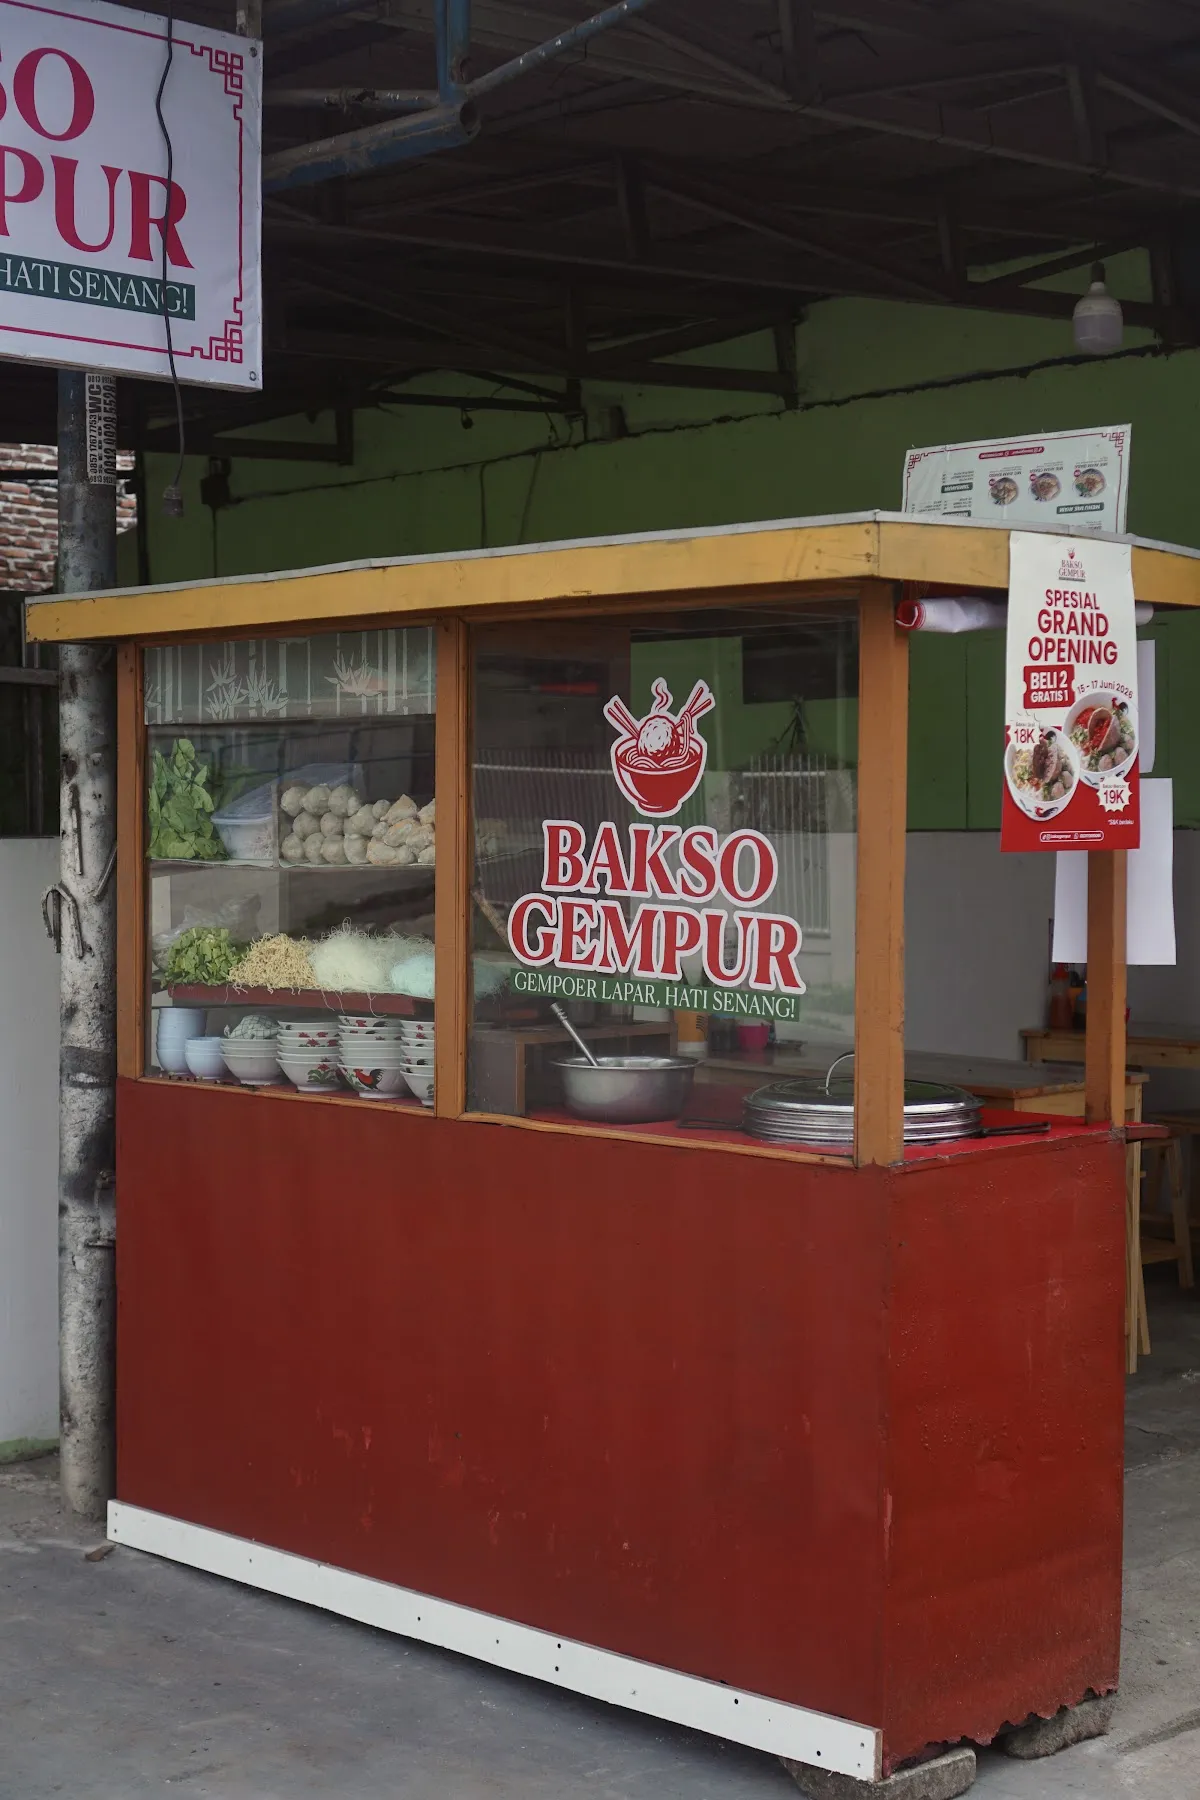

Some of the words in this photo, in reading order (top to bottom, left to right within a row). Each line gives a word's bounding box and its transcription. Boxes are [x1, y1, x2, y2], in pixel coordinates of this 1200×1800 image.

[0, 47, 95, 141] O
[68, 268, 188, 314] SENANG!
[88, 384, 102, 414] WC
[1058, 568, 1086, 578] GEMPUR
[1061, 559, 1083, 569] BAKSO
[1045, 588, 1100, 610] SPESIAL
[1037, 609, 1109, 637] GRAND
[1028, 636, 1118, 665] OPENING
[1030, 671, 1057, 690] BELI
[1059, 670, 1068, 688] 2
[1077, 685, 1086, 694] 15
[1091, 680, 1098, 689] 17
[1100, 681, 1115, 690] Juni
[1116, 682, 1133, 699] 2026
[1030, 690, 1063, 703] GRATIS
[1063, 690, 1069, 701] 1
[1014, 728, 1036, 744] 18K
[1103, 790, 1125, 804] 19K
[543, 821, 777, 905] BAKSO
[509, 895, 804, 990] GEMPUR
[514, 971, 598, 999] GEMPOER
[601, 981, 660, 1007] LAPAR,
[665, 987, 708, 1010] HATI
[713, 990, 795, 1018] SENANG!
